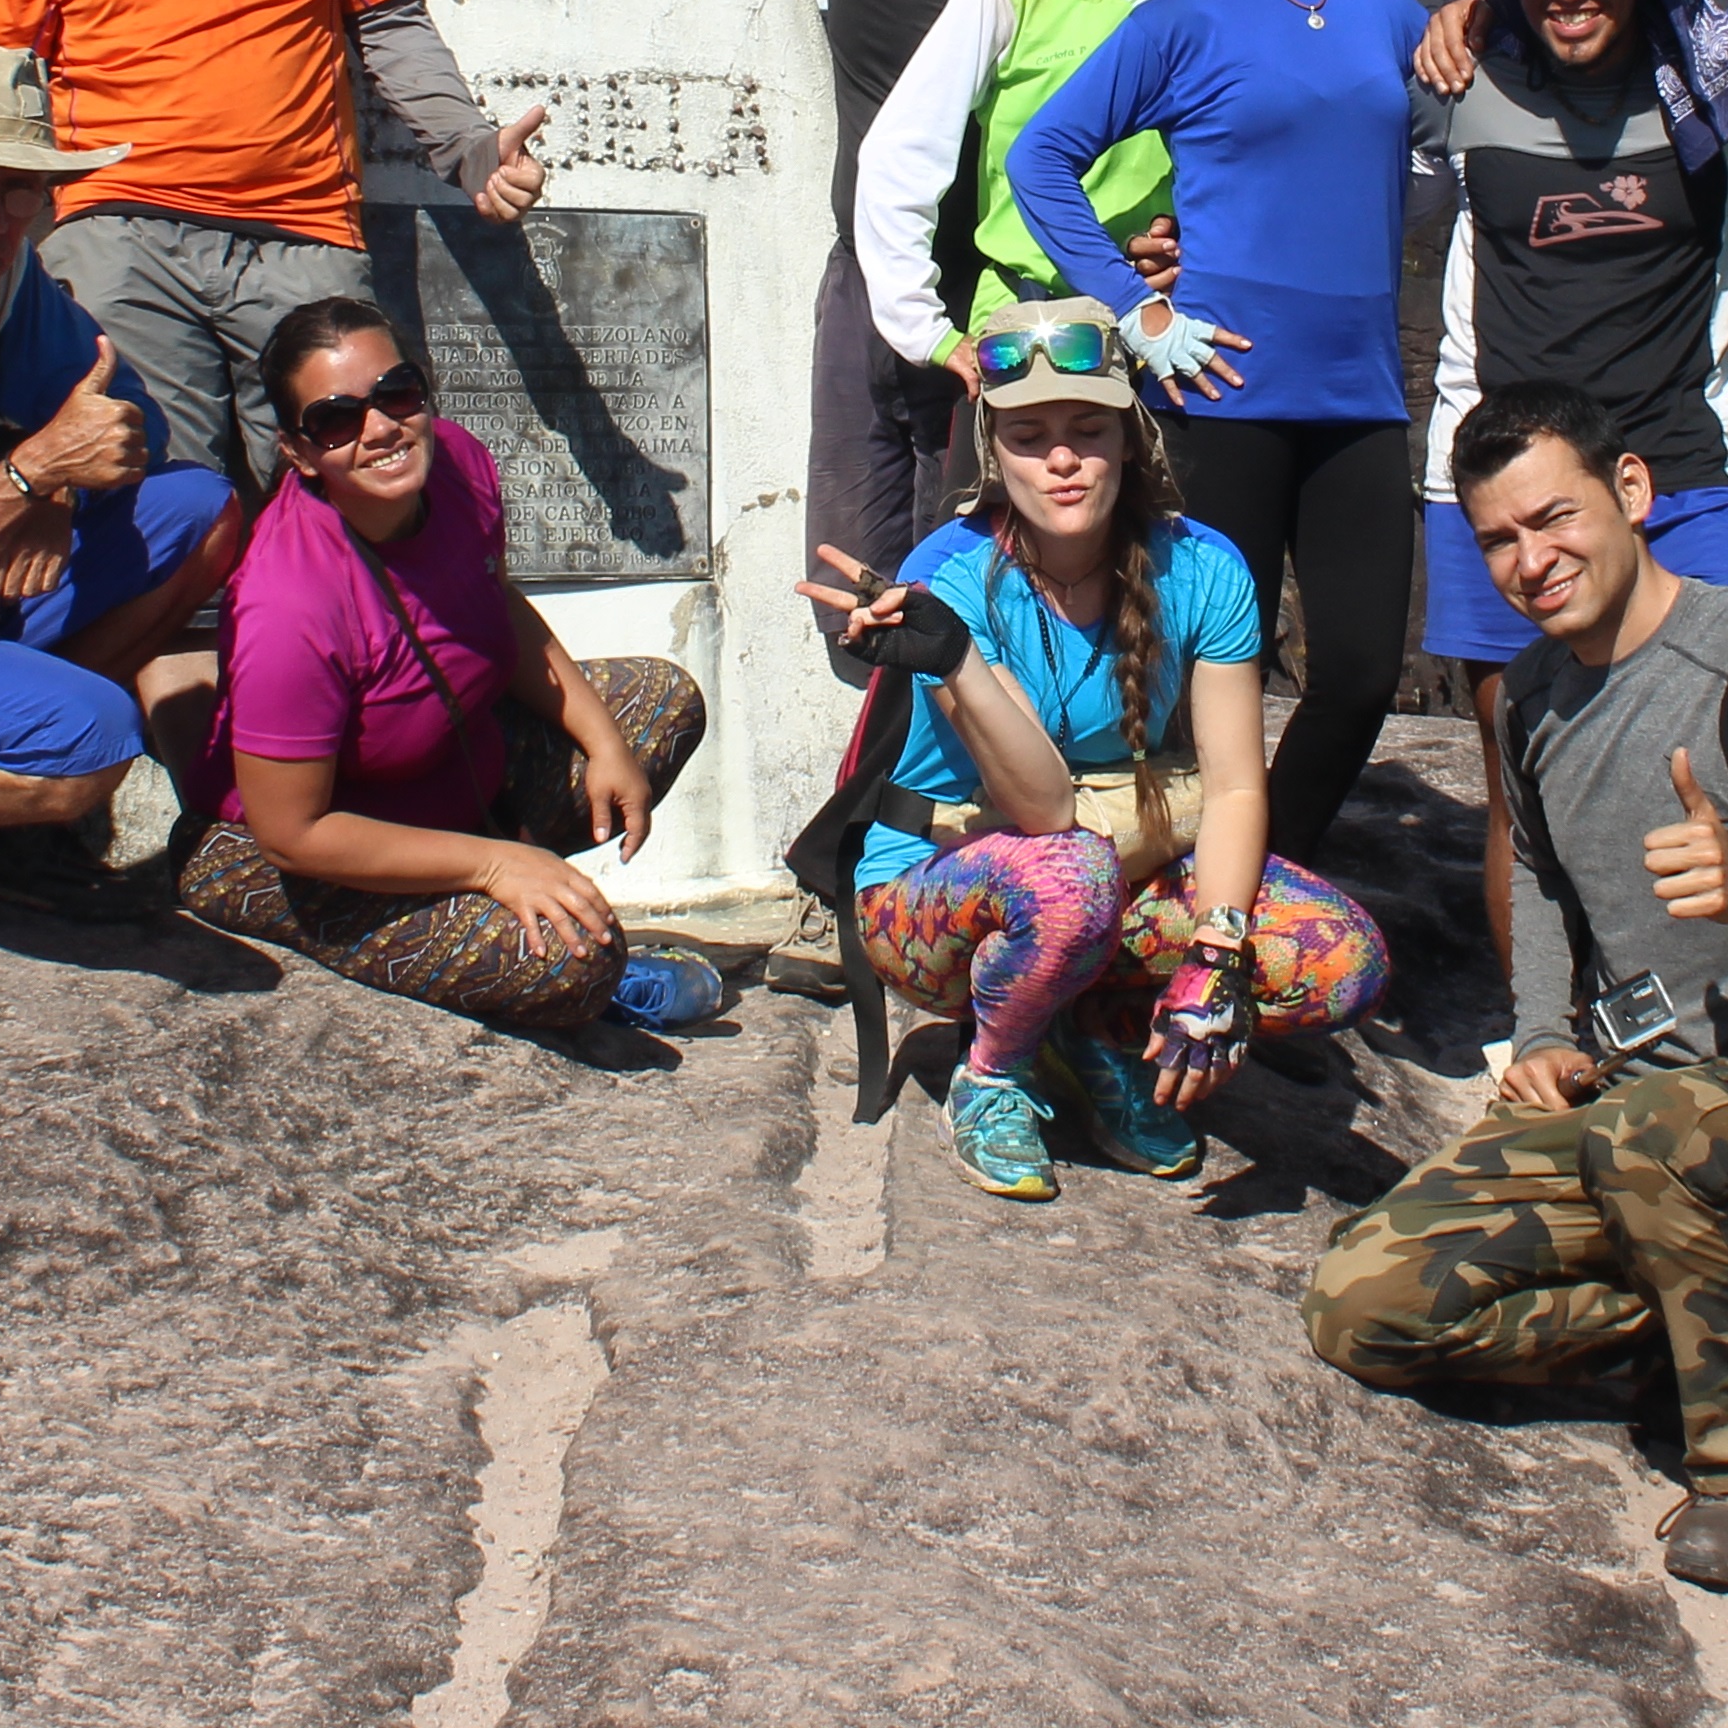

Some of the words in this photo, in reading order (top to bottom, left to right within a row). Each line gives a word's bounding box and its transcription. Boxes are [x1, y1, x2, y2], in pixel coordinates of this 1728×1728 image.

[436, 370, 479, 386] CON
[616, 372, 648, 388] LA
[672, 393, 686, 410] A
[453, 415, 504, 432] HITO
[660, 415, 690, 432] EN
[625, 482, 652, 499] LA
[508, 505, 536, 522] DE
[544, 505, 658, 522] CARABOBO
[508, 552, 532, 566] DE
[541, 552, 596, 566] JUNIO
[600, 552, 624, 566] DE
